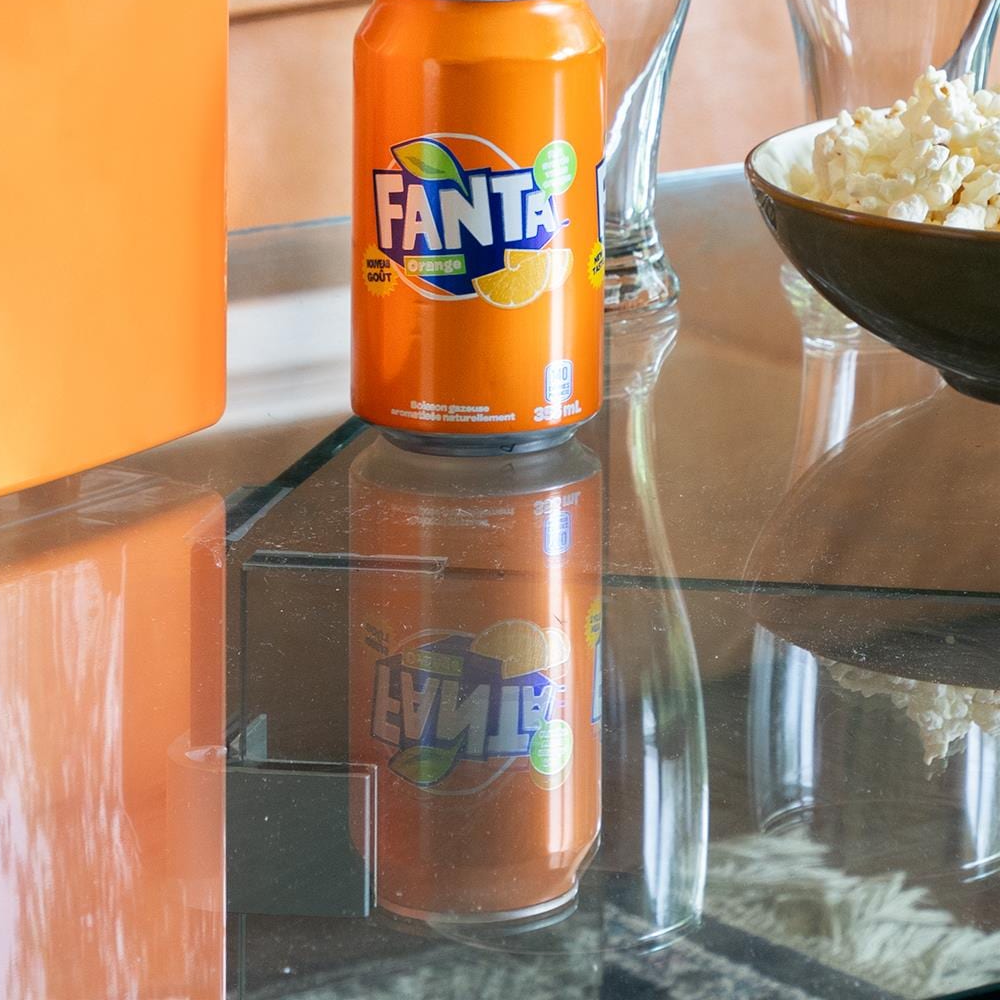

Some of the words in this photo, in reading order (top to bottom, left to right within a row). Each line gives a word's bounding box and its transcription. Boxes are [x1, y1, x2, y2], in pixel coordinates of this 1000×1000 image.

[375, 172, 557, 251] FANTA
[407, 259, 462, 274] Orange
[367, 269, 392, 283] GOÛT
[442, 412, 517, 422] naturellement
